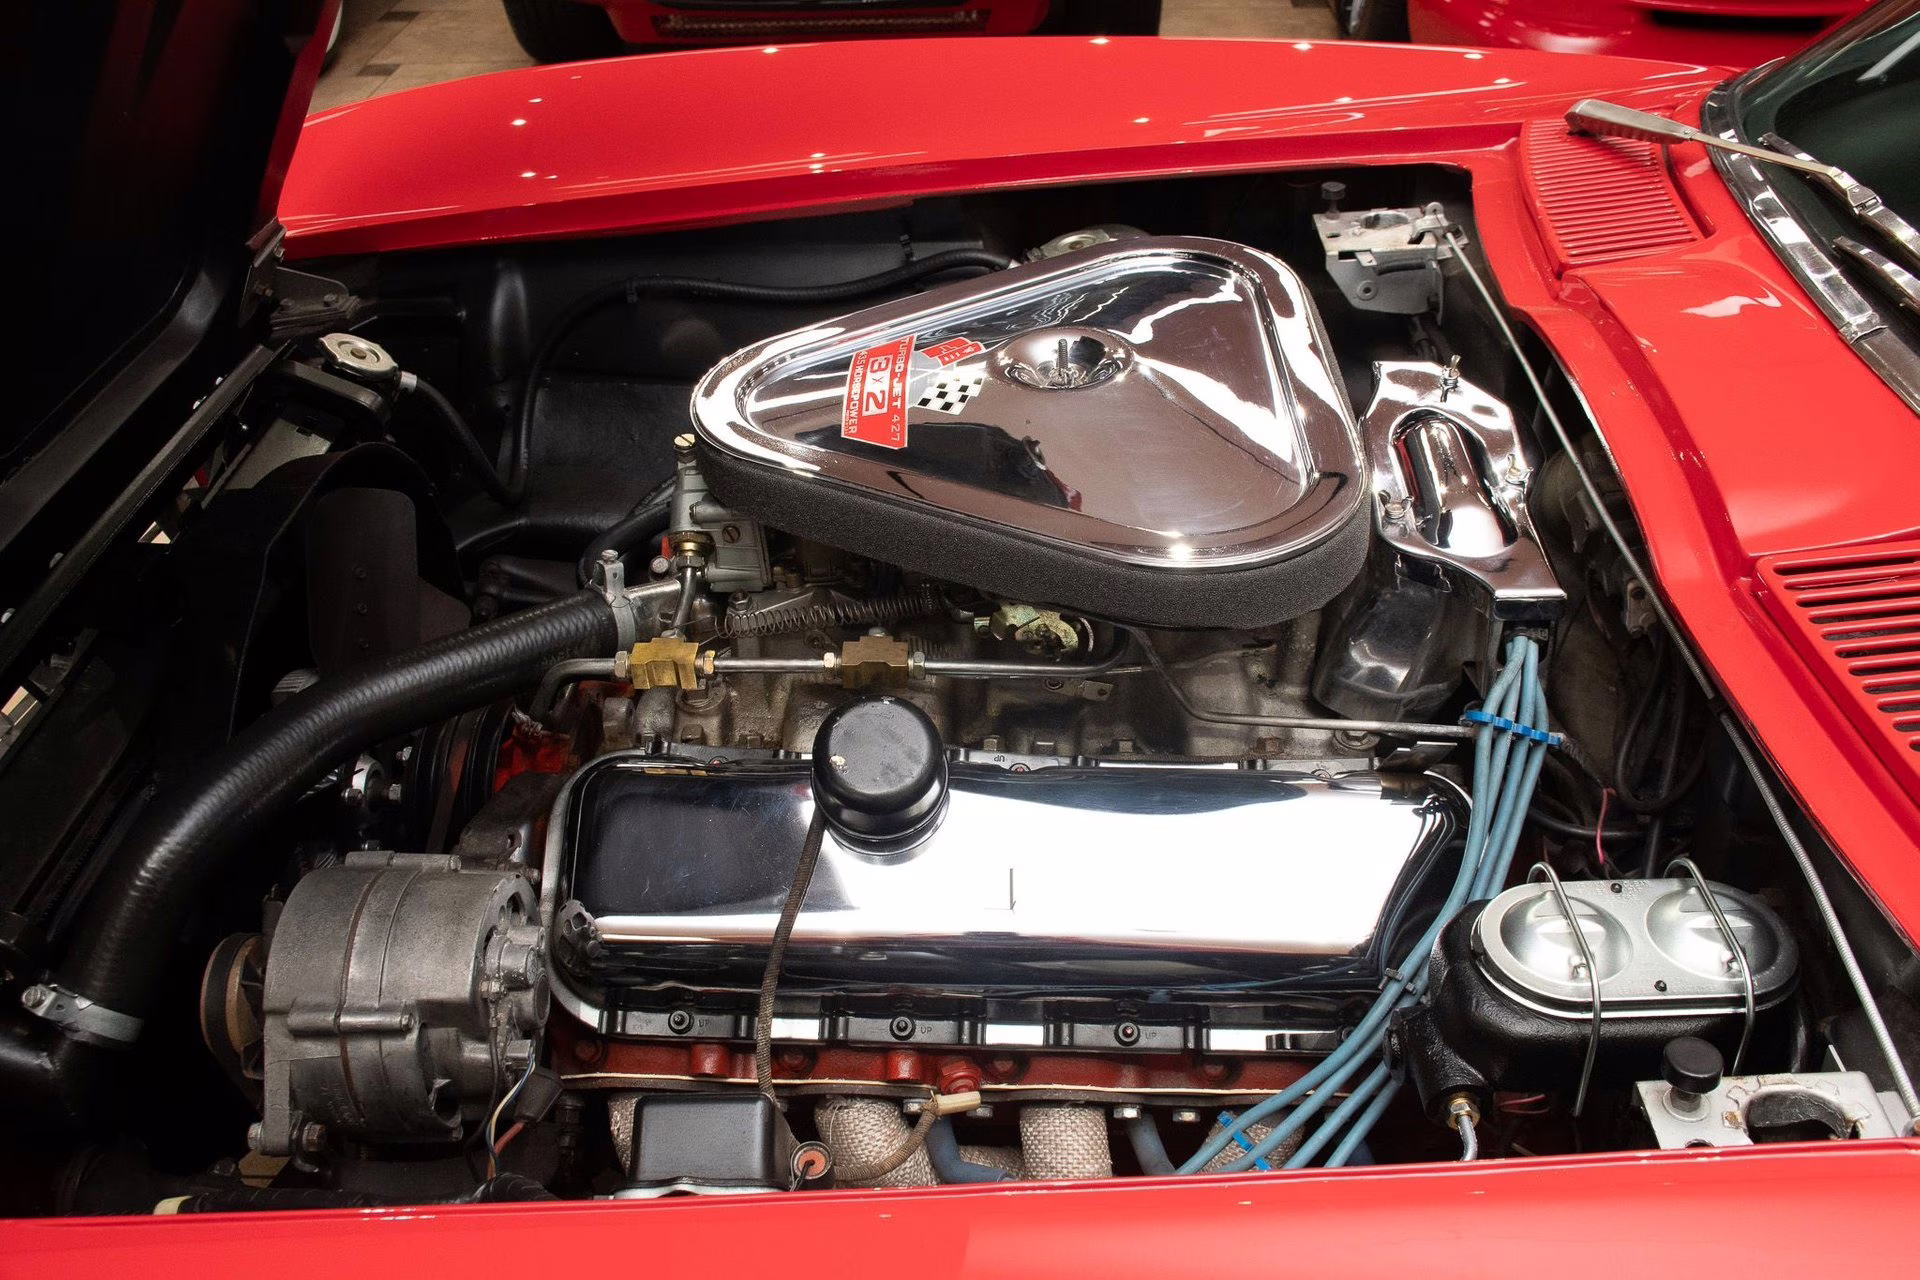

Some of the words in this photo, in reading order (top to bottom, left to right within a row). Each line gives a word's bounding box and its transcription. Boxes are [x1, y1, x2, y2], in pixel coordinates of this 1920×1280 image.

[857, 351, 868, 365] 435
[892, 337, 909, 409] TURBO-JET
[848, 365, 865, 434] HORSEPOWER
[891, 414, 901, 441] 427
[993, 754, 1005, 762] UP
[920, 1026, 932, 1034] UP
[1145, 1032, 1157, 1040] UP
